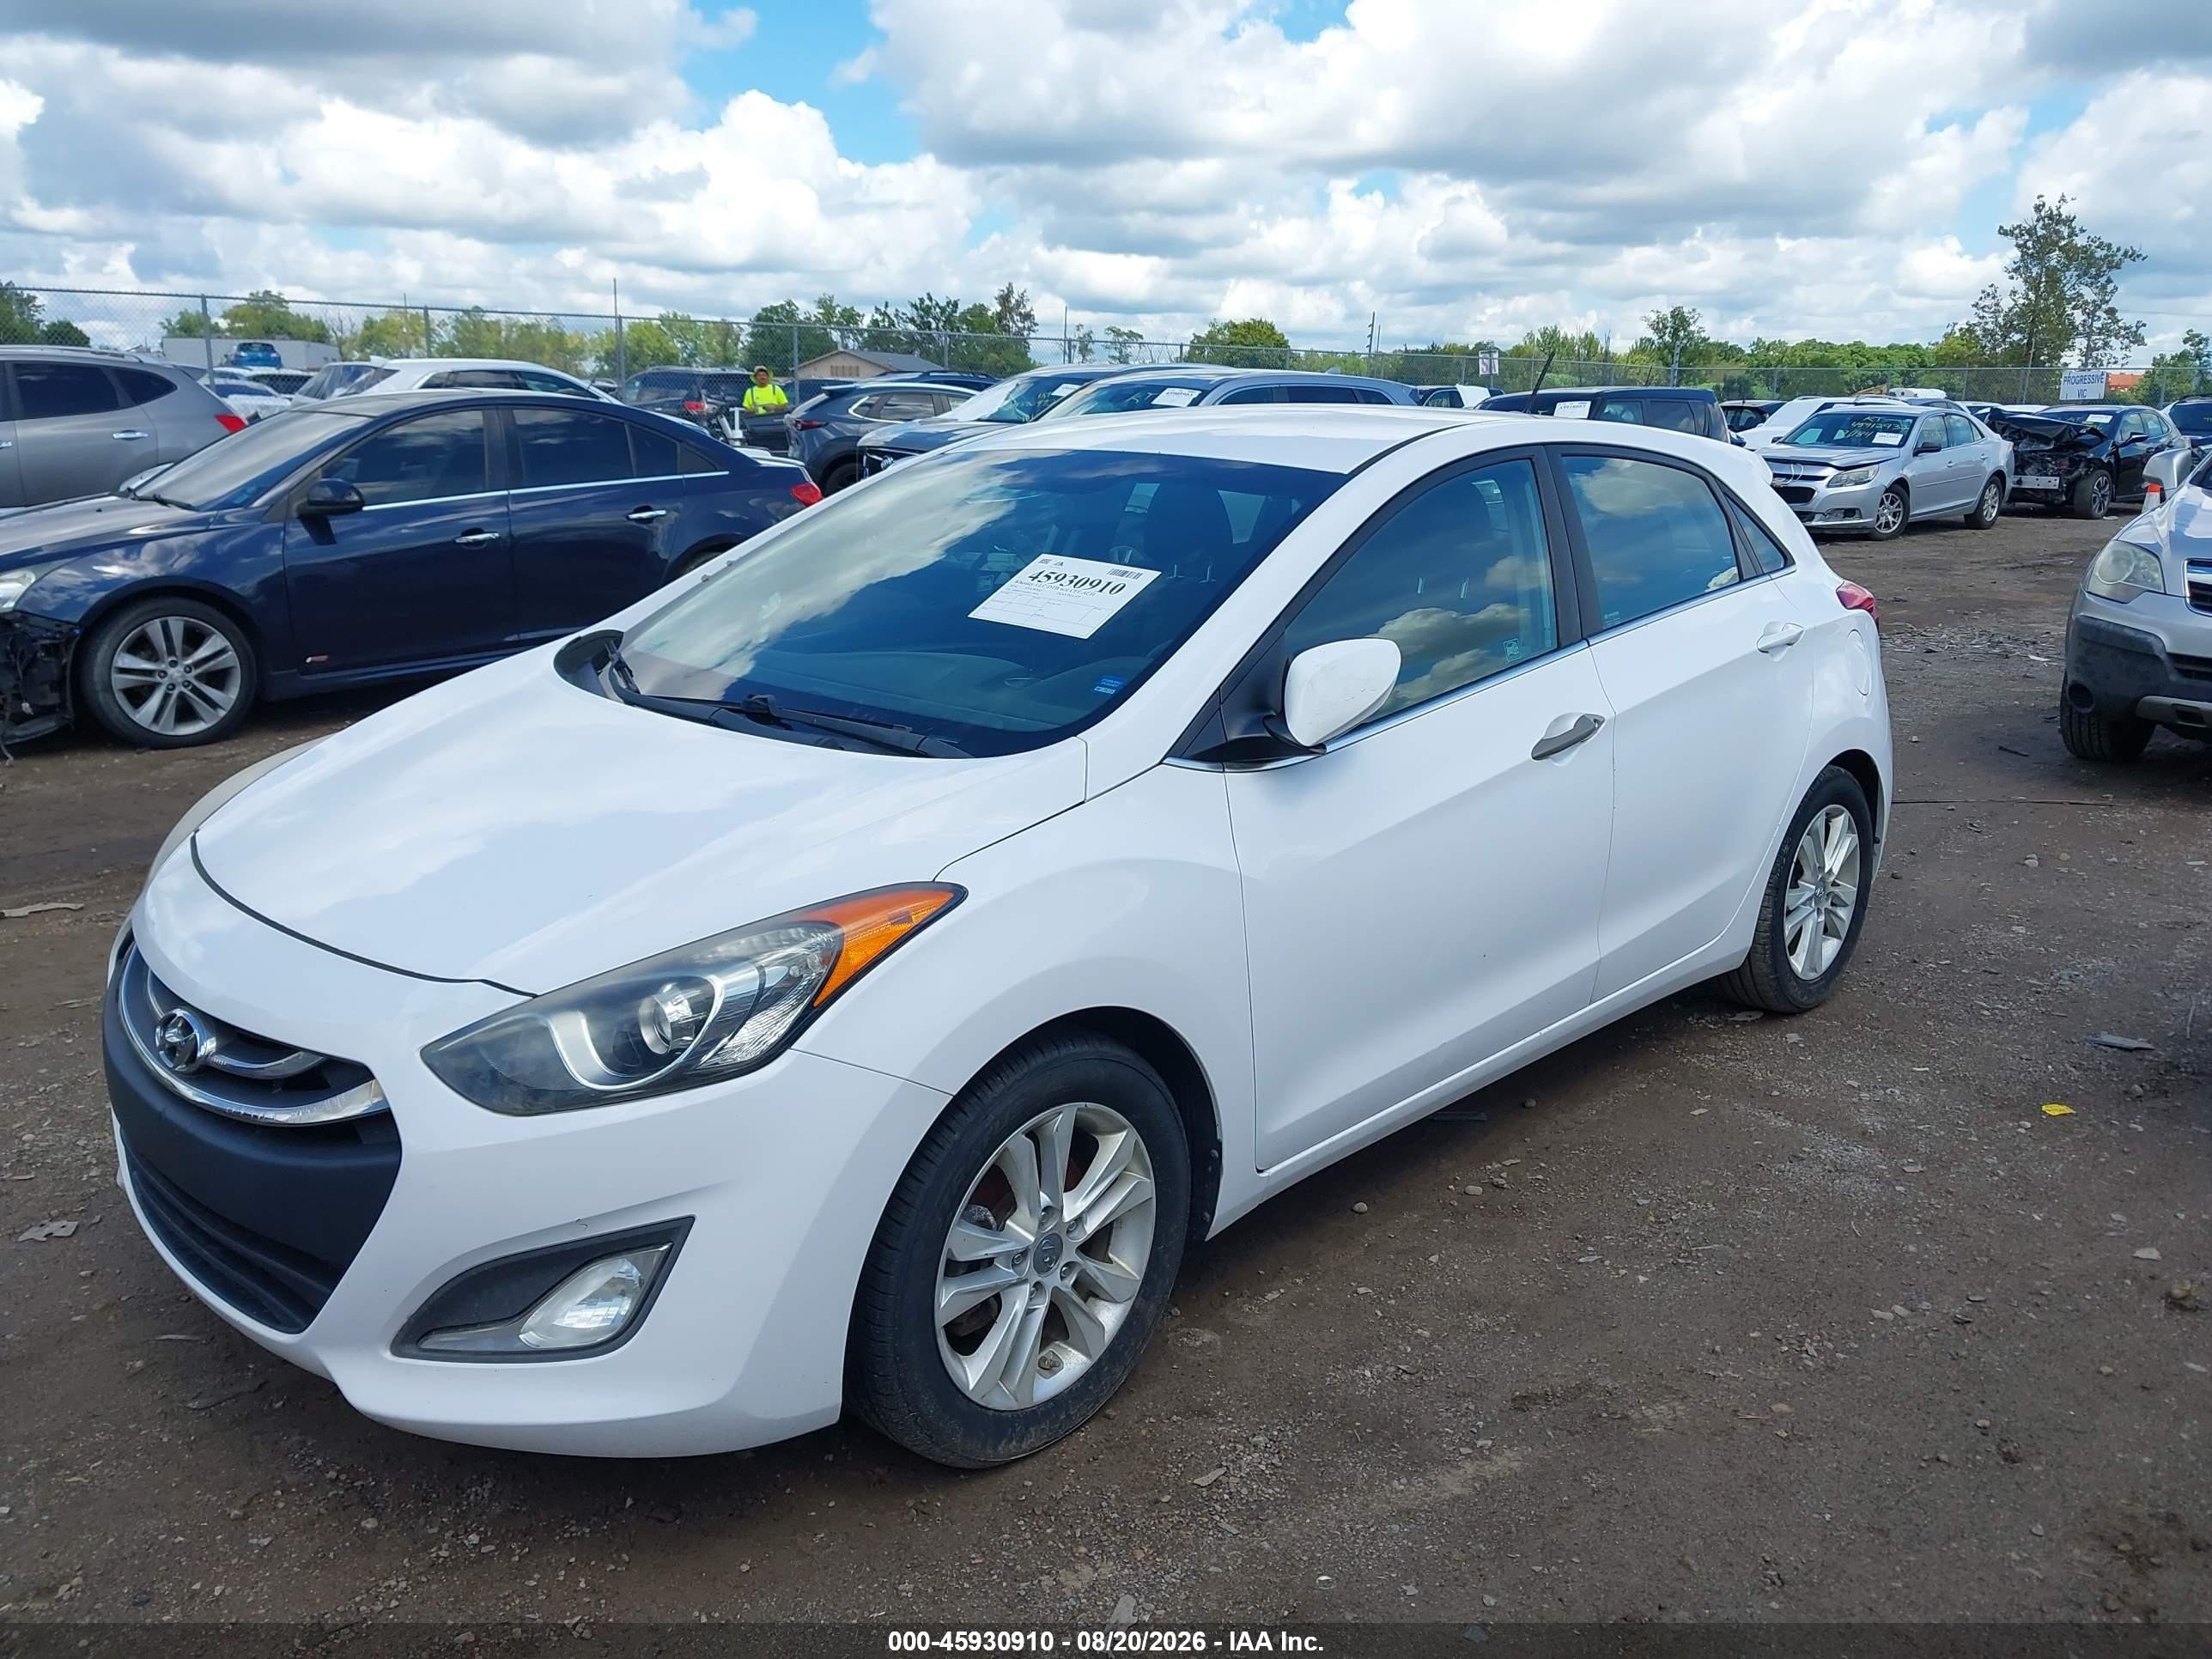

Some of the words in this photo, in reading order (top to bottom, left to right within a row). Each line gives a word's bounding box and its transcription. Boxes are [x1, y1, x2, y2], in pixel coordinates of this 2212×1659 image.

[2063, 374, 2104, 386] PROGRESSIVE
[2078, 389, 2087, 398] VIC
[1028, 569, 1127, 595] 45930910
